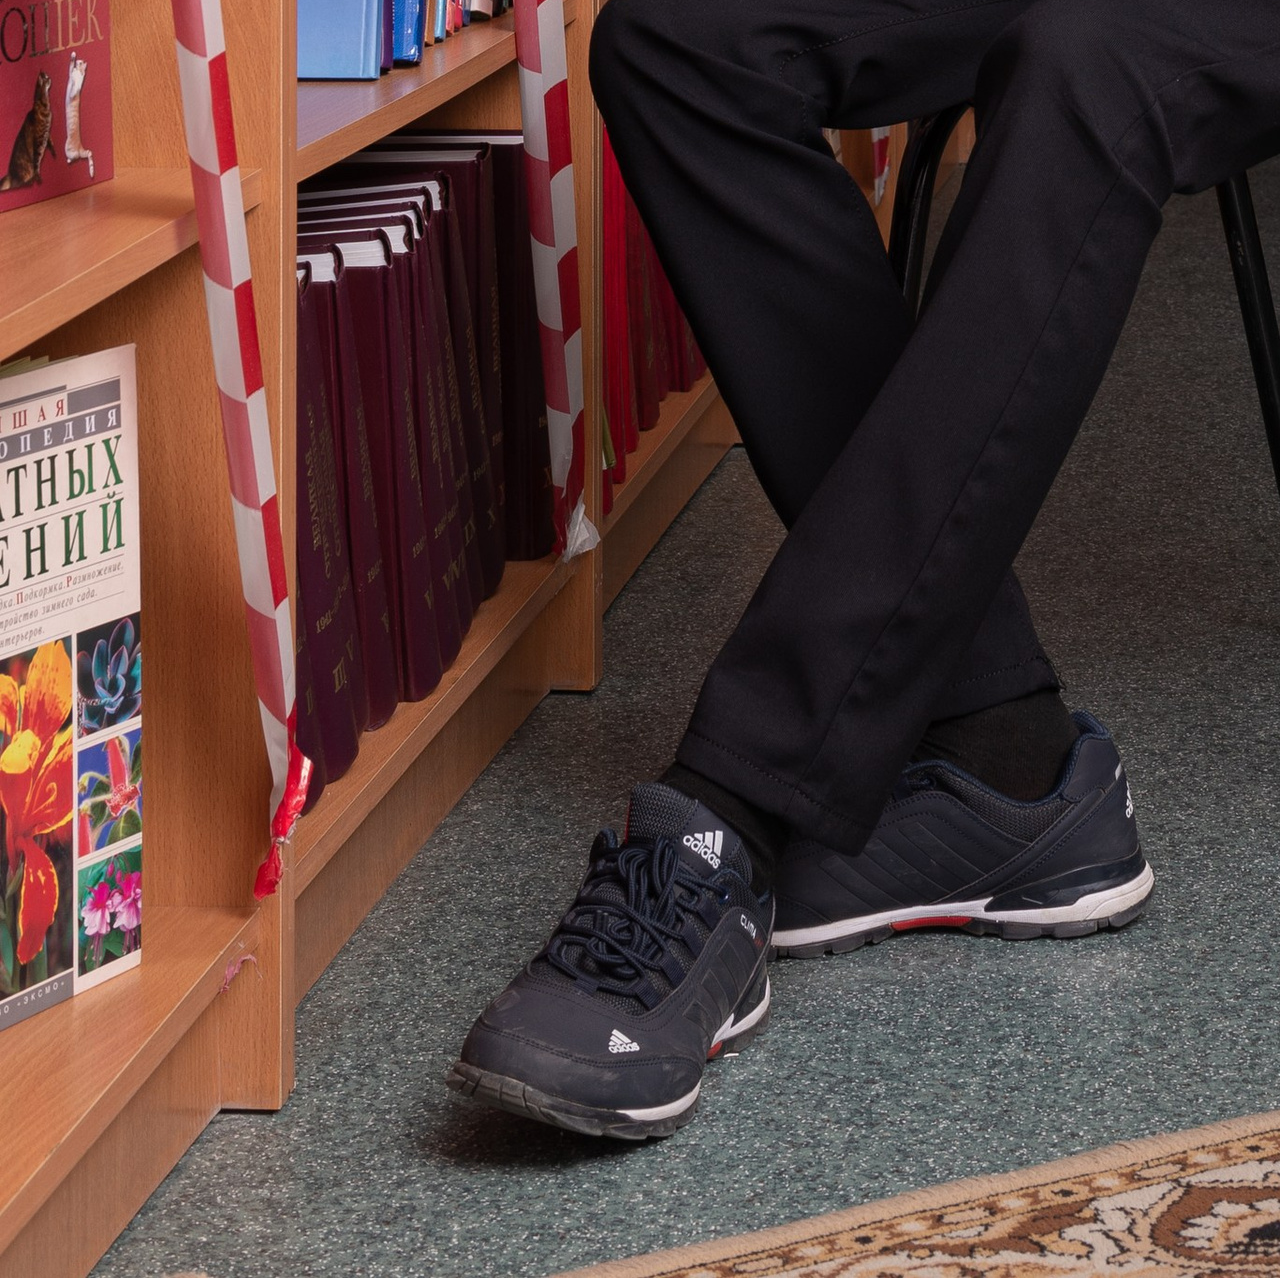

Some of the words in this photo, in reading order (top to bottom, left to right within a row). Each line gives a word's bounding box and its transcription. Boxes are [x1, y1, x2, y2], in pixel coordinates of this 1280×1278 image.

[0, 398, 65, 434] ШАЯ
[0, 434, 124, 522] ТНЫХ
[41, 598, 74, 619] зимнего
[76, 589, 98, 604] сада.
[683, 834, 722, 870] adidas
[608, 1040, 640, 1055] adidas
